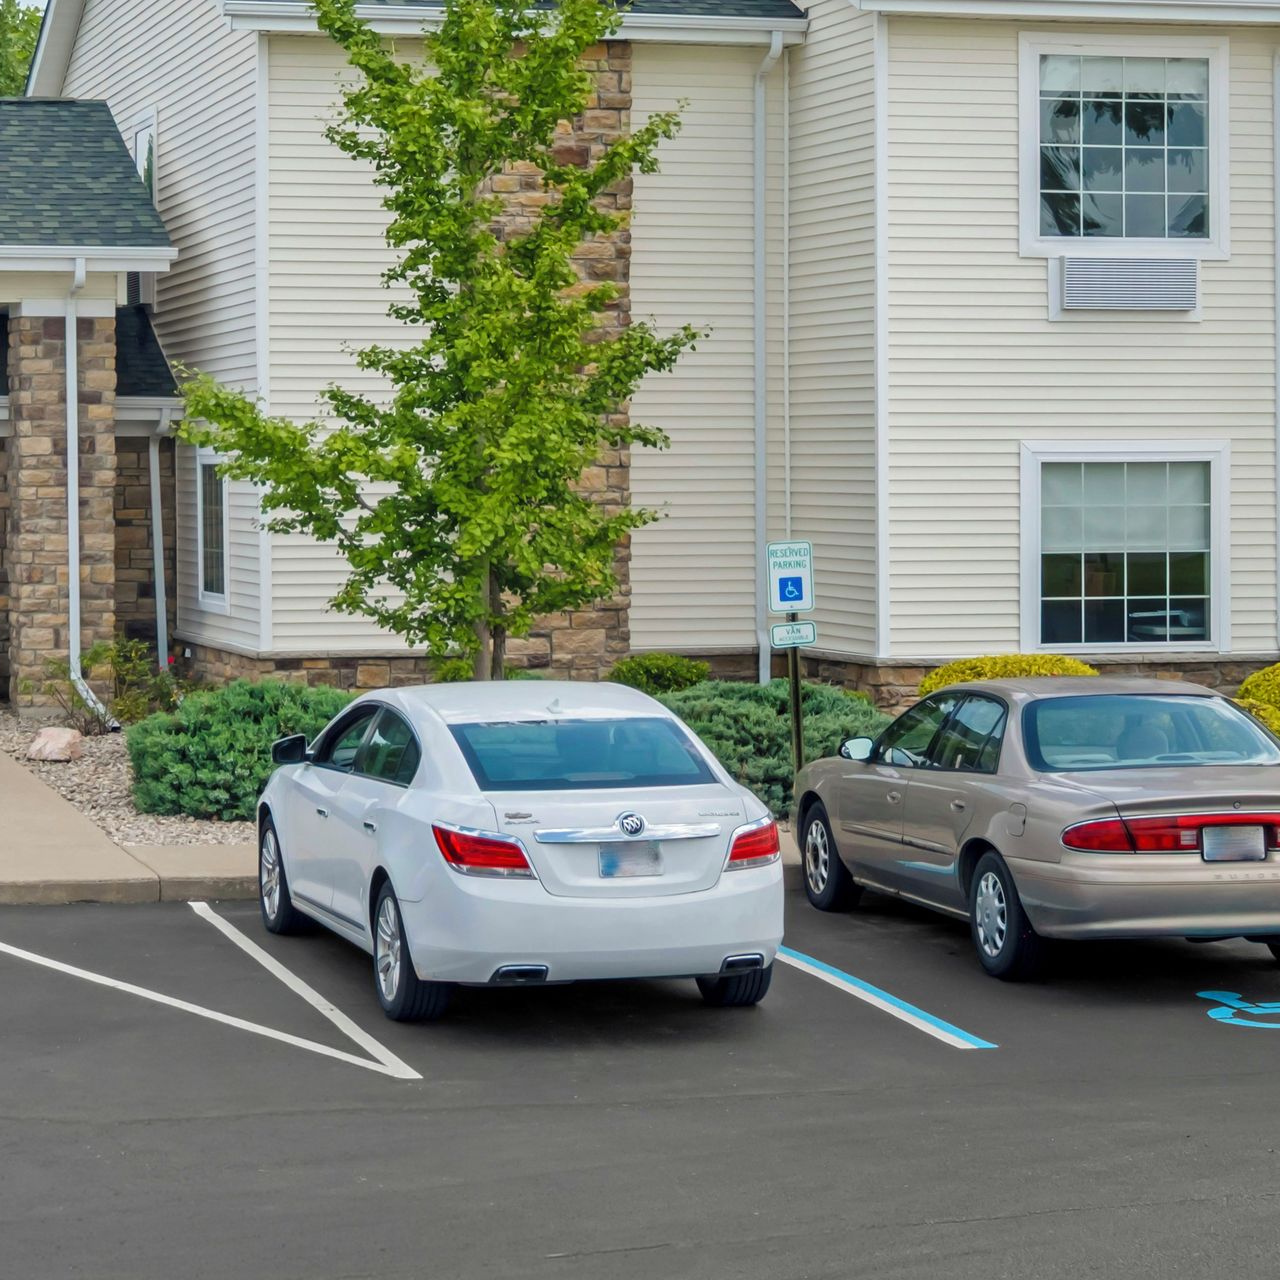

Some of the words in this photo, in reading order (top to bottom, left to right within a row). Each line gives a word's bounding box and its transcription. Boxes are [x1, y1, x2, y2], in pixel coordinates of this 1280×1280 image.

[770, 547, 809, 559] RESERVED
[773, 560, 807, 570] PARKING
[785, 627, 801, 635] VAN
